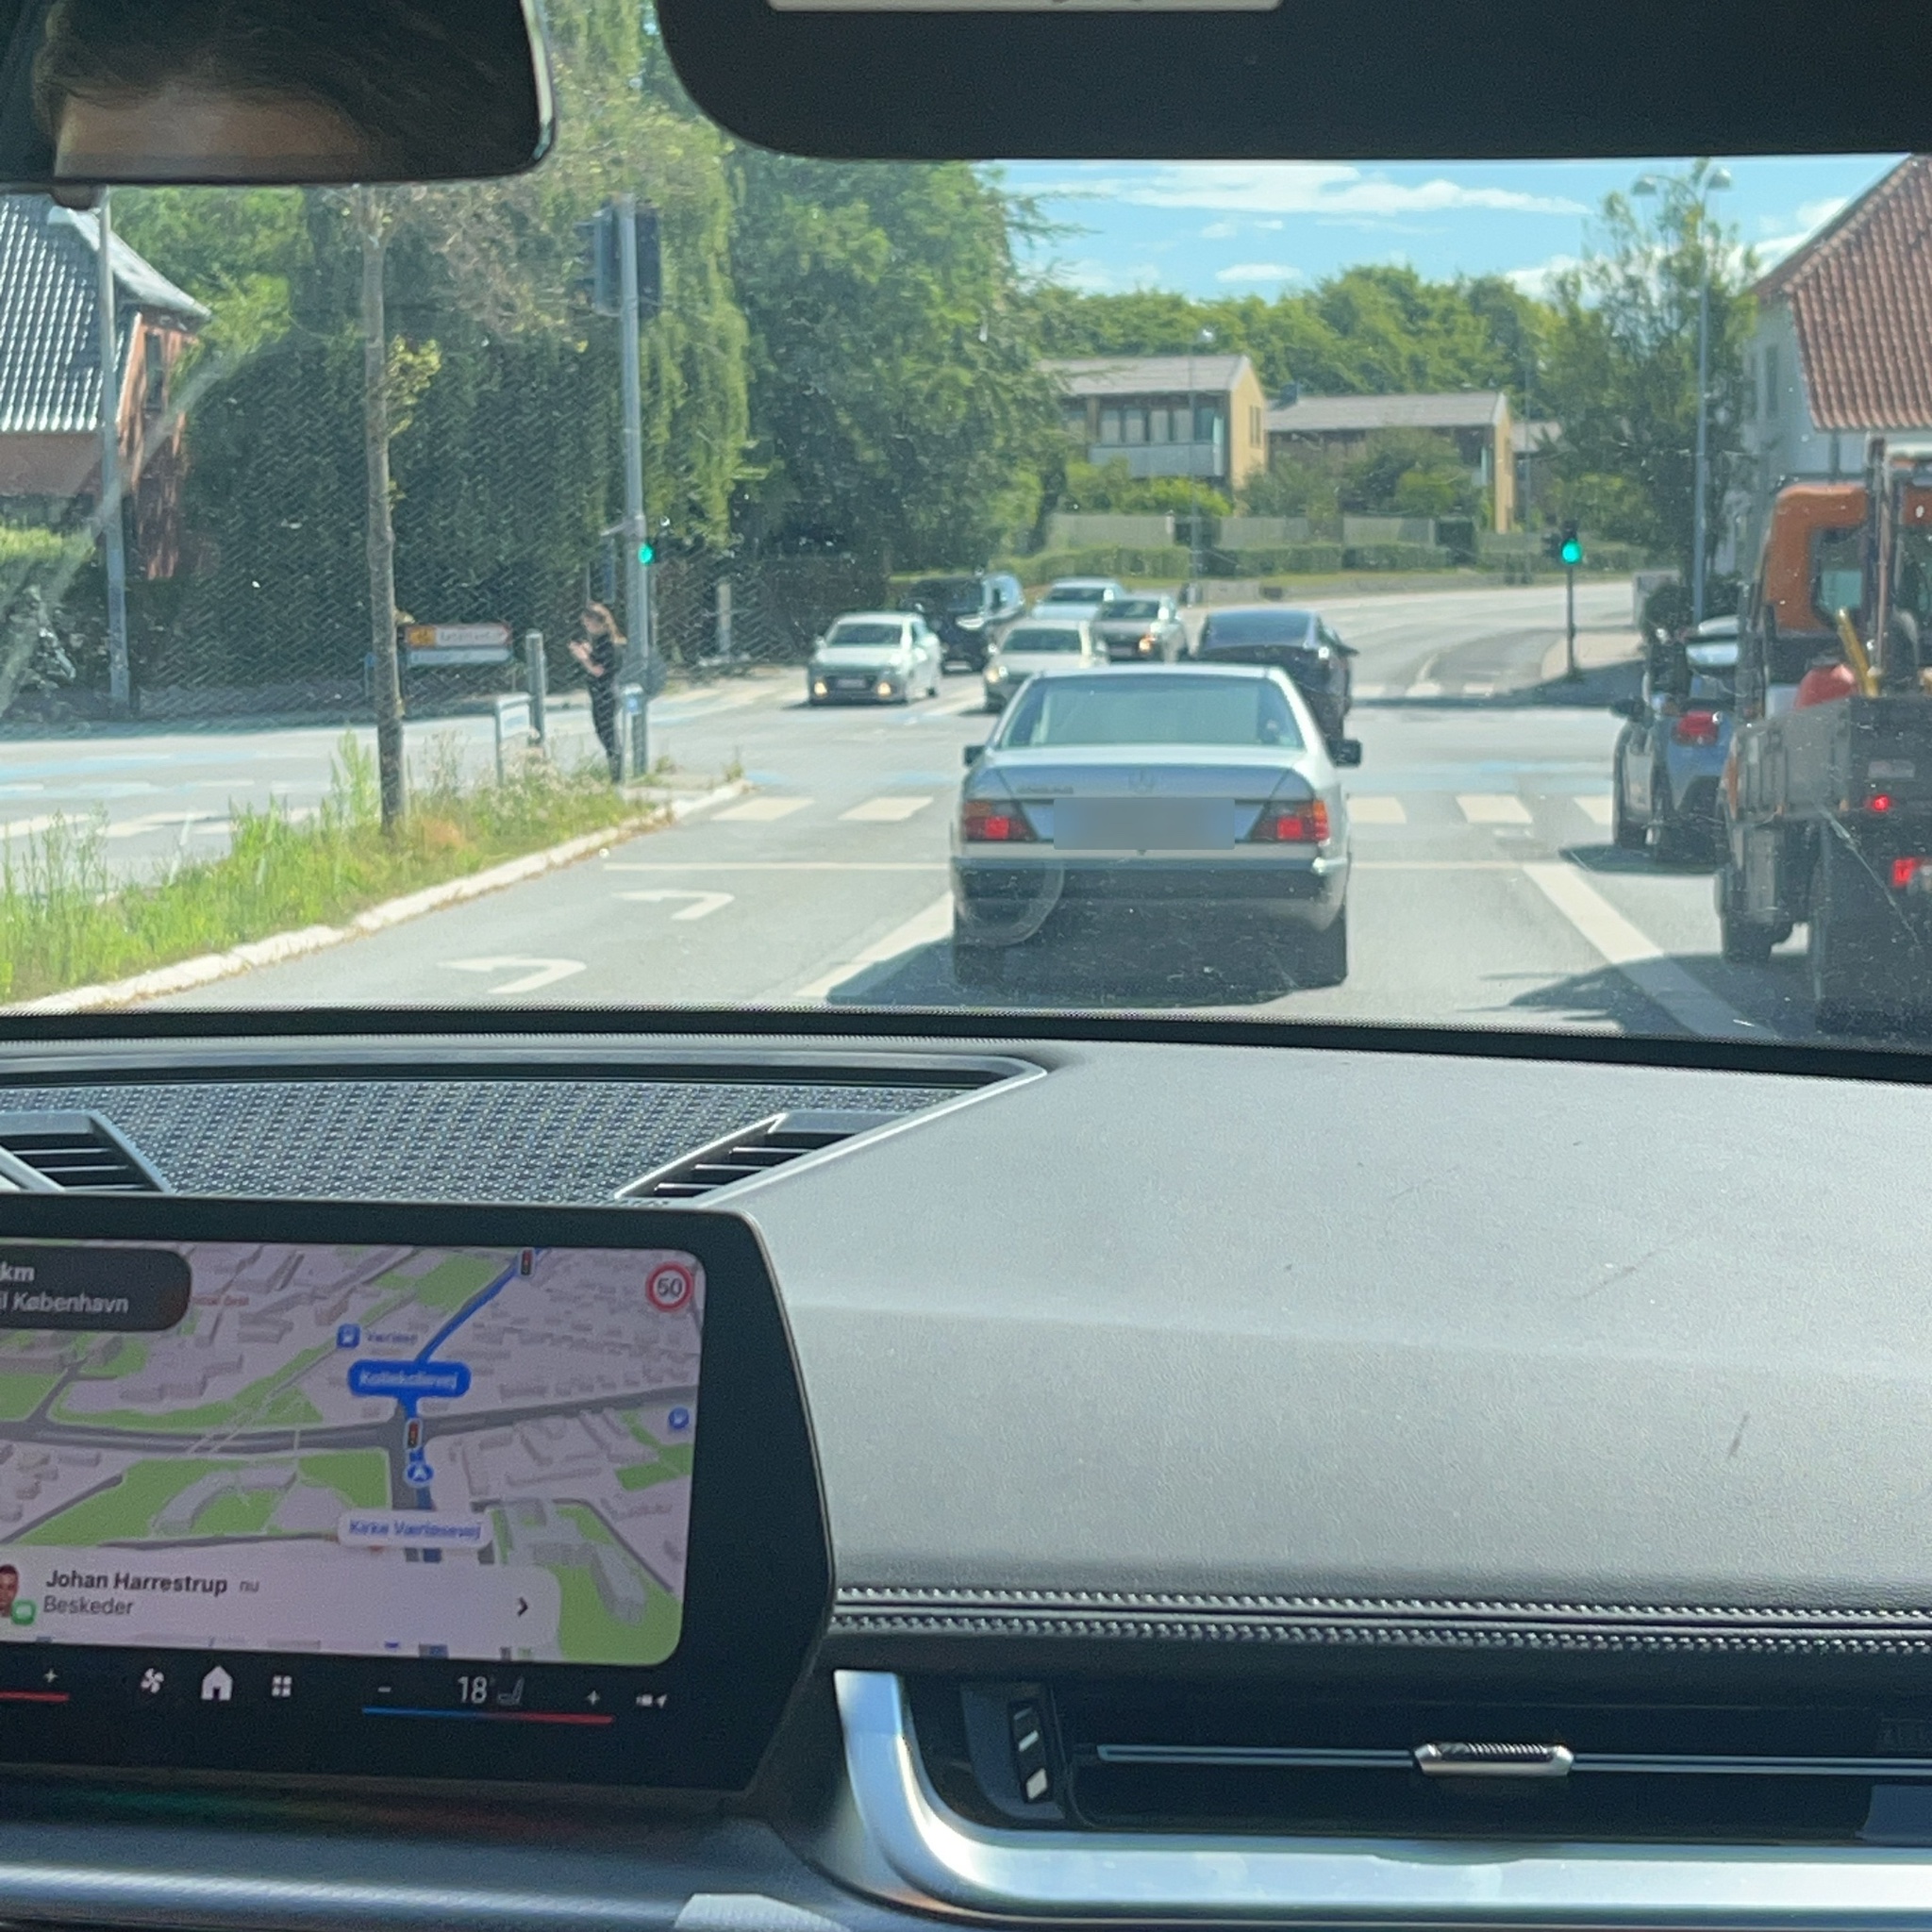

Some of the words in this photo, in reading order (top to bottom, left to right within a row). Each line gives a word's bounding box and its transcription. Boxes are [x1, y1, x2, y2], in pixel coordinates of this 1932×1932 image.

[0, 1262, 35, 1282] km
[658, 1277, 683, 1297] 50
[12, 1291, 129, 1314] København
[45, 1570, 108, 1589] Johan
[113, 1572, 227, 1597] Harrestrup
[239, 1580, 259, 1592] nu
[43, 1595, 134, 1615] Beskeder
[457, 1675, 488, 1704] 18
